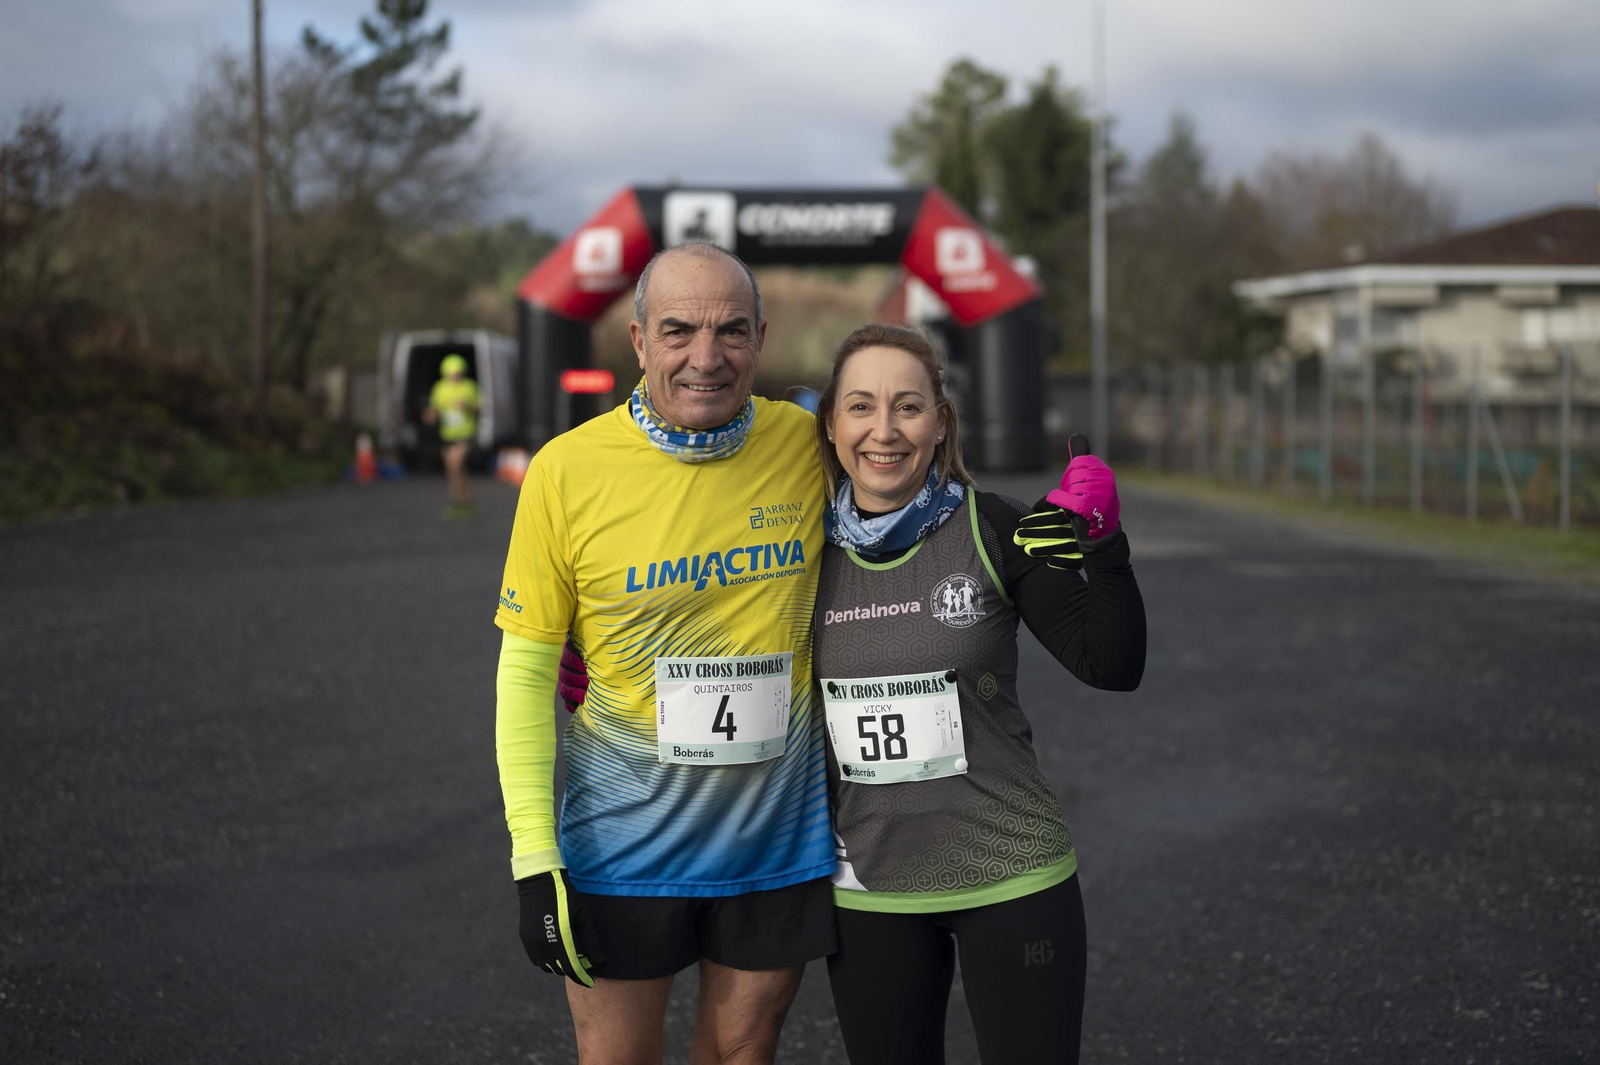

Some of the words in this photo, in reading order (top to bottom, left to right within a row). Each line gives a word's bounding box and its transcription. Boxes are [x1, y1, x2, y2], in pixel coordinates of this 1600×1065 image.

[765, 502, 804, 515] ARRANZ
[626, 539, 806, 593] LIMIACTIVA
[728, 573, 775, 586] ASOCIACIÓN
[775, 567, 806, 579] DEPORTIVA
[824, 601, 921, 626] Dentalnova
[667, 663, 692, 678] XXV
[695, 662, 733, 678] CROSS
[736, 656, 784, 677] BOBORÁS
[693, 683, 753, 695] QUINTAIROS
[850, 683, 885, 699] CROSS
[886, 676, 947, 697] BOBORÁS
[711, 694, 737, 741] 4
[863, 704, 893, 714] VICKY
[857, 713, 909, 762] 58
